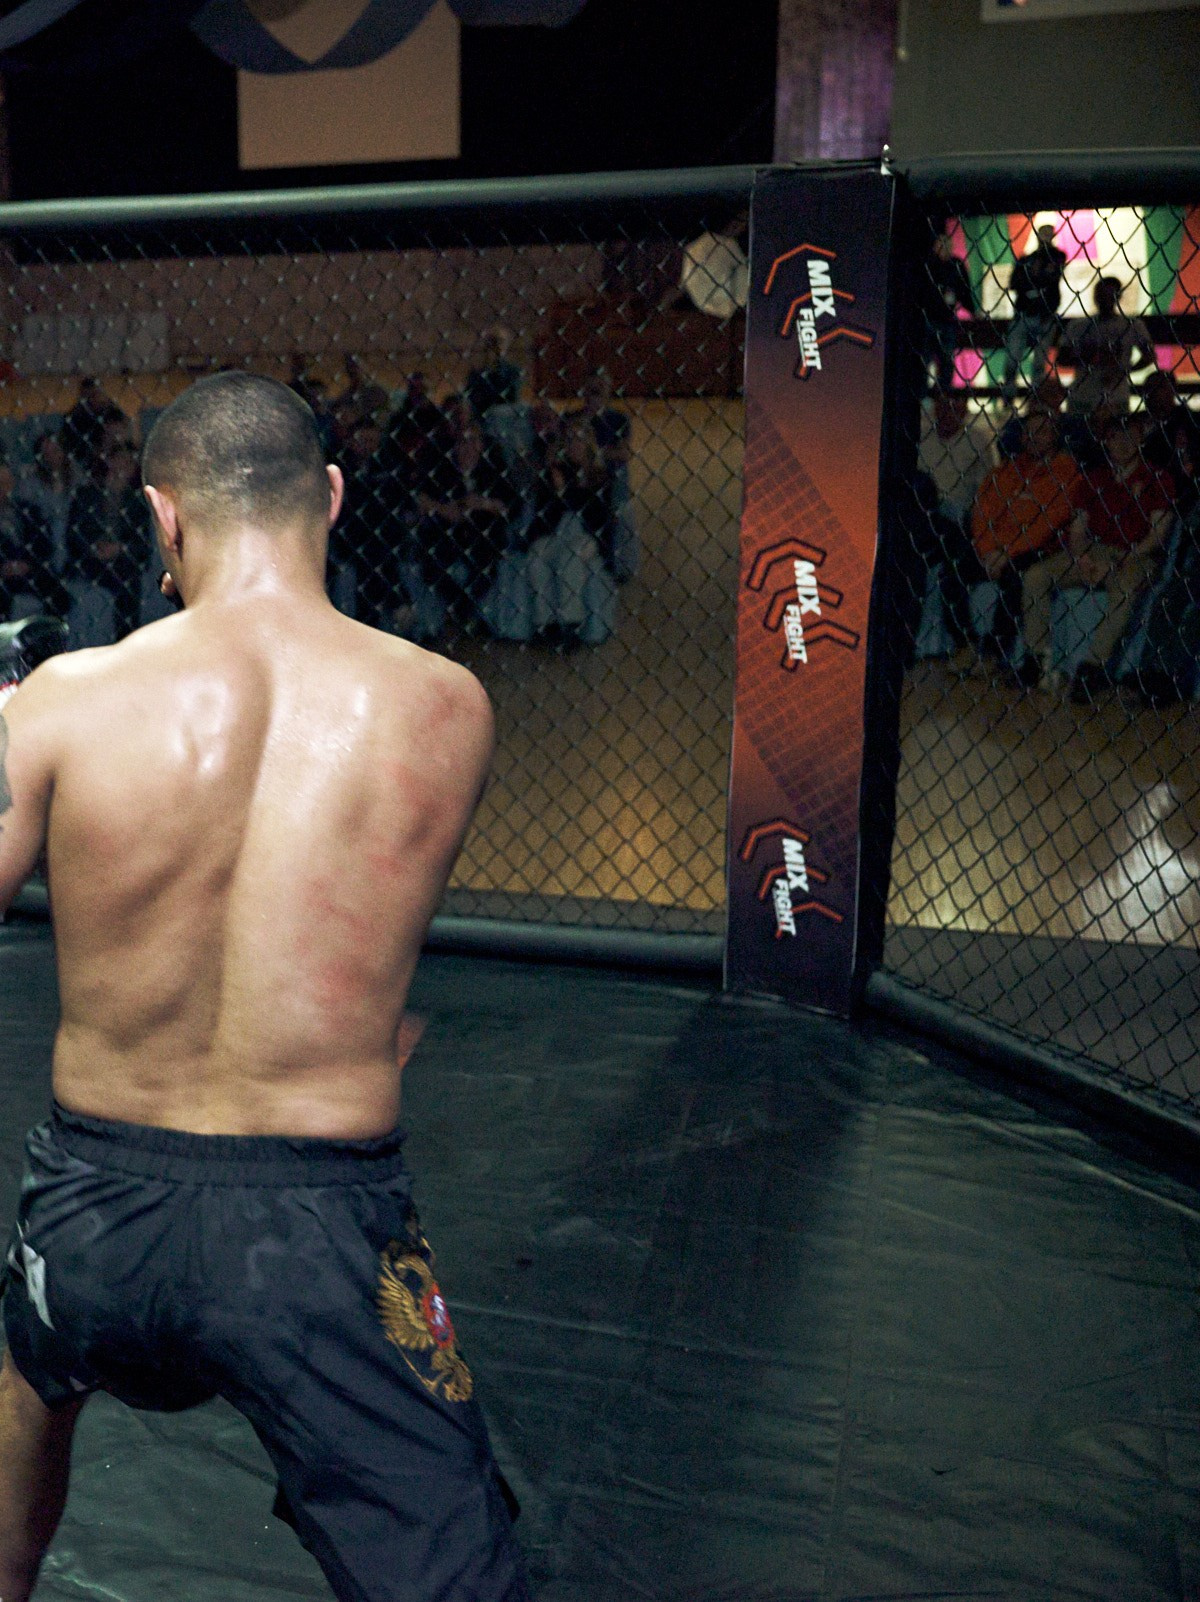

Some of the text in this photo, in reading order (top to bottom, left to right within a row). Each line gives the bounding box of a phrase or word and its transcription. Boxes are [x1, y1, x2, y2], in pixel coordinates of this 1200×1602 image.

[806, 259, 837, 318] MIX
[797, 307, 823, 371] FIGHT
[793, 559, 822, 617] MIX
[784, 603, 808, 665] FIGHT
[781, 838, 809, 894] MIX
[773, 877, 797, 938] FIGHT
